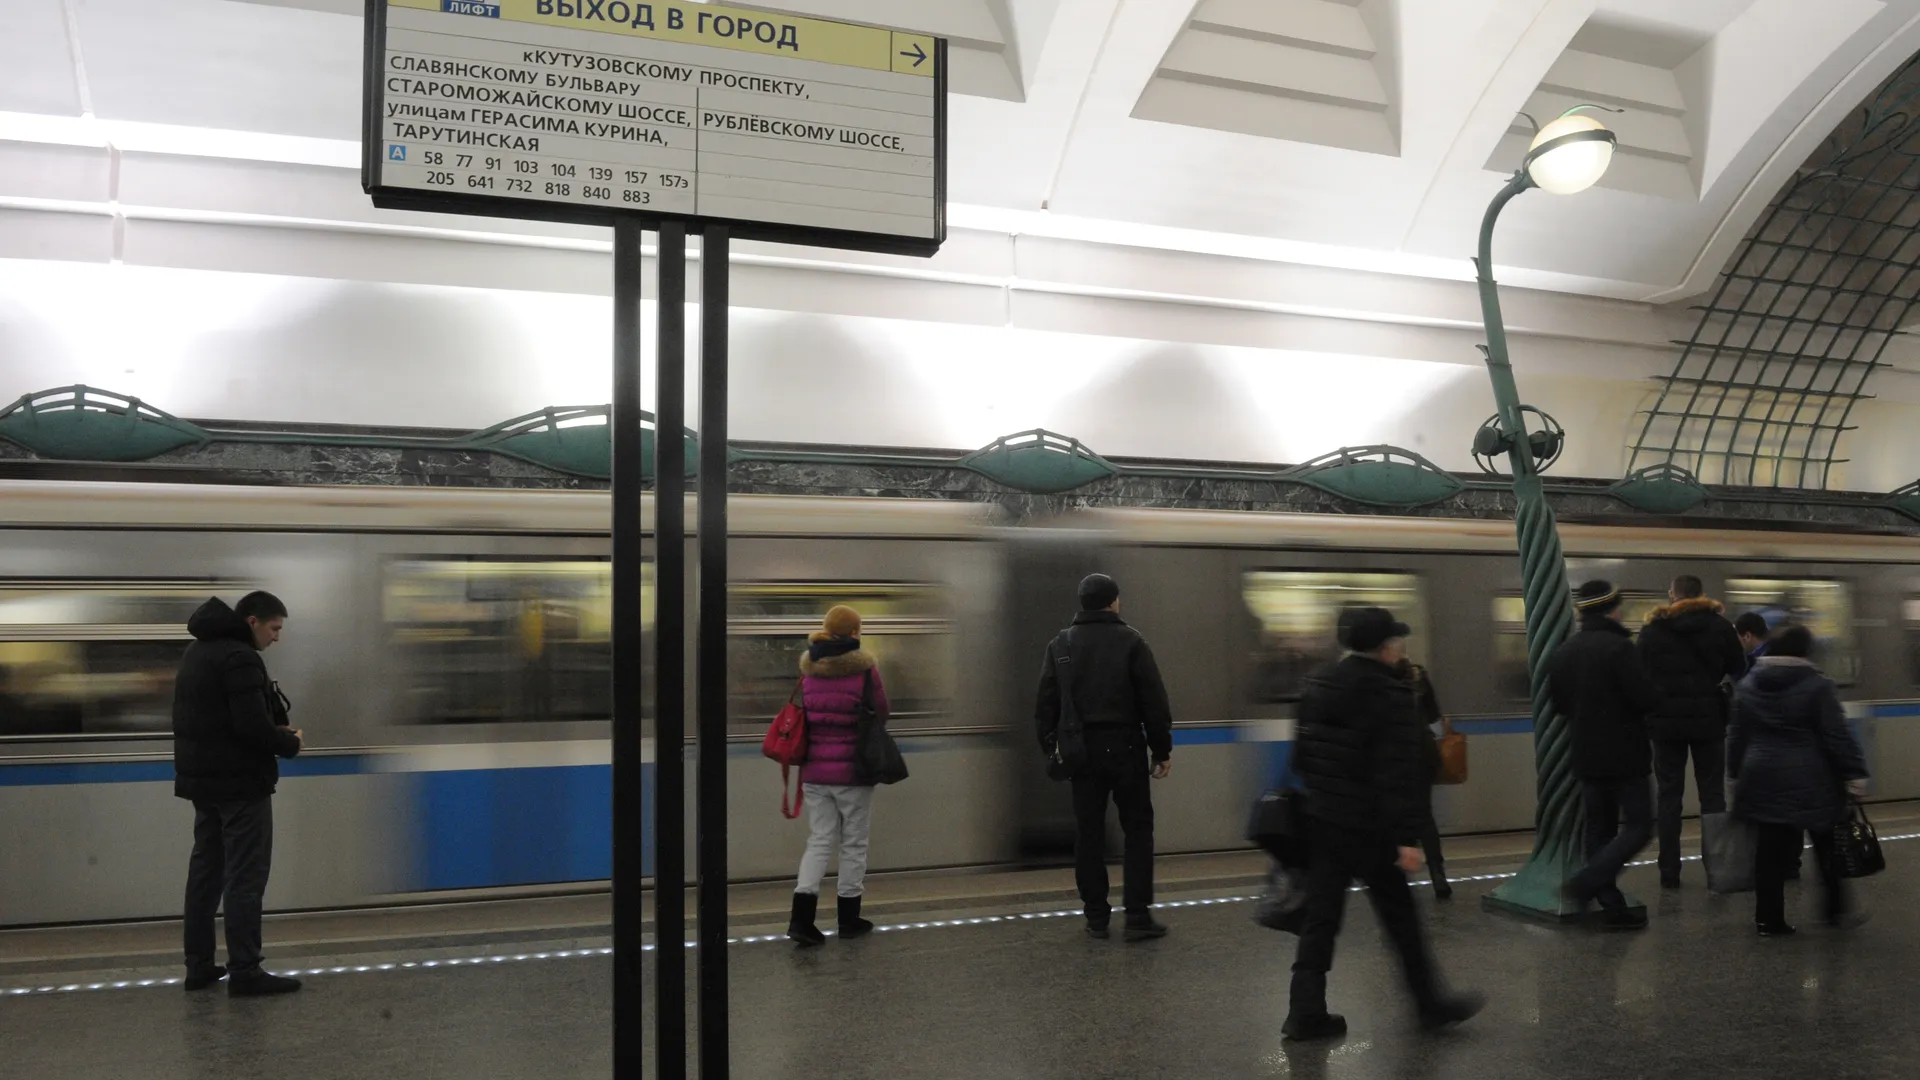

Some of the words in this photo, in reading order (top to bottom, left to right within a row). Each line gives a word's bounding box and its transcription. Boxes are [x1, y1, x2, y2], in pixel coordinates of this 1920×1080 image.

[537, 0, 654, 30] ВЫХОД
[667, 8, 683, 29] В
[698, 12, 798, 51] ГОРОД
[390, 55, 538, 85] СЛАВЯНСКОМУ
[546, 73, 641, 96] БУЛЬВАРУ
[700, 70, 810, 99] ПРОСПЕКТУ,
[388, 78, 613, 115] СТАРОМОЖАЙСКОМУ
[618, 104, 691, 126] ШОССЕ,
[388, 102, 465, 122] улицам
[471, 109, 579, 134] ГЕРАСИМА
[585, 122, 668, 146] КУРИНА,
[393, 123, 539, 151] ТАРУТИНСКАЯ
[703, 112, 834, 142] РУБЛЁВСКОМУ
[840, 130, 905, 152] ШОССЕ,
[424, 152, 443, 164] 58
[456, 154, 473, 167] 77
[485, 157, 501, 170] 91
[514, 160, 538, 173] 103
[551, 164, 576, 177] 104
[589, 167, 612, 180] 139
[625, 171, 647, 184] 157
[660, 174, 688, 188] 157э
[427, 171, 454, 185] 205
[468, 175, 494, 189] 641
[506, 179, 533, 193] 732
[545, 183, 570, 196] 818
[583, 186, 610, 200] 840
[623, 189, 650, 203] 883
